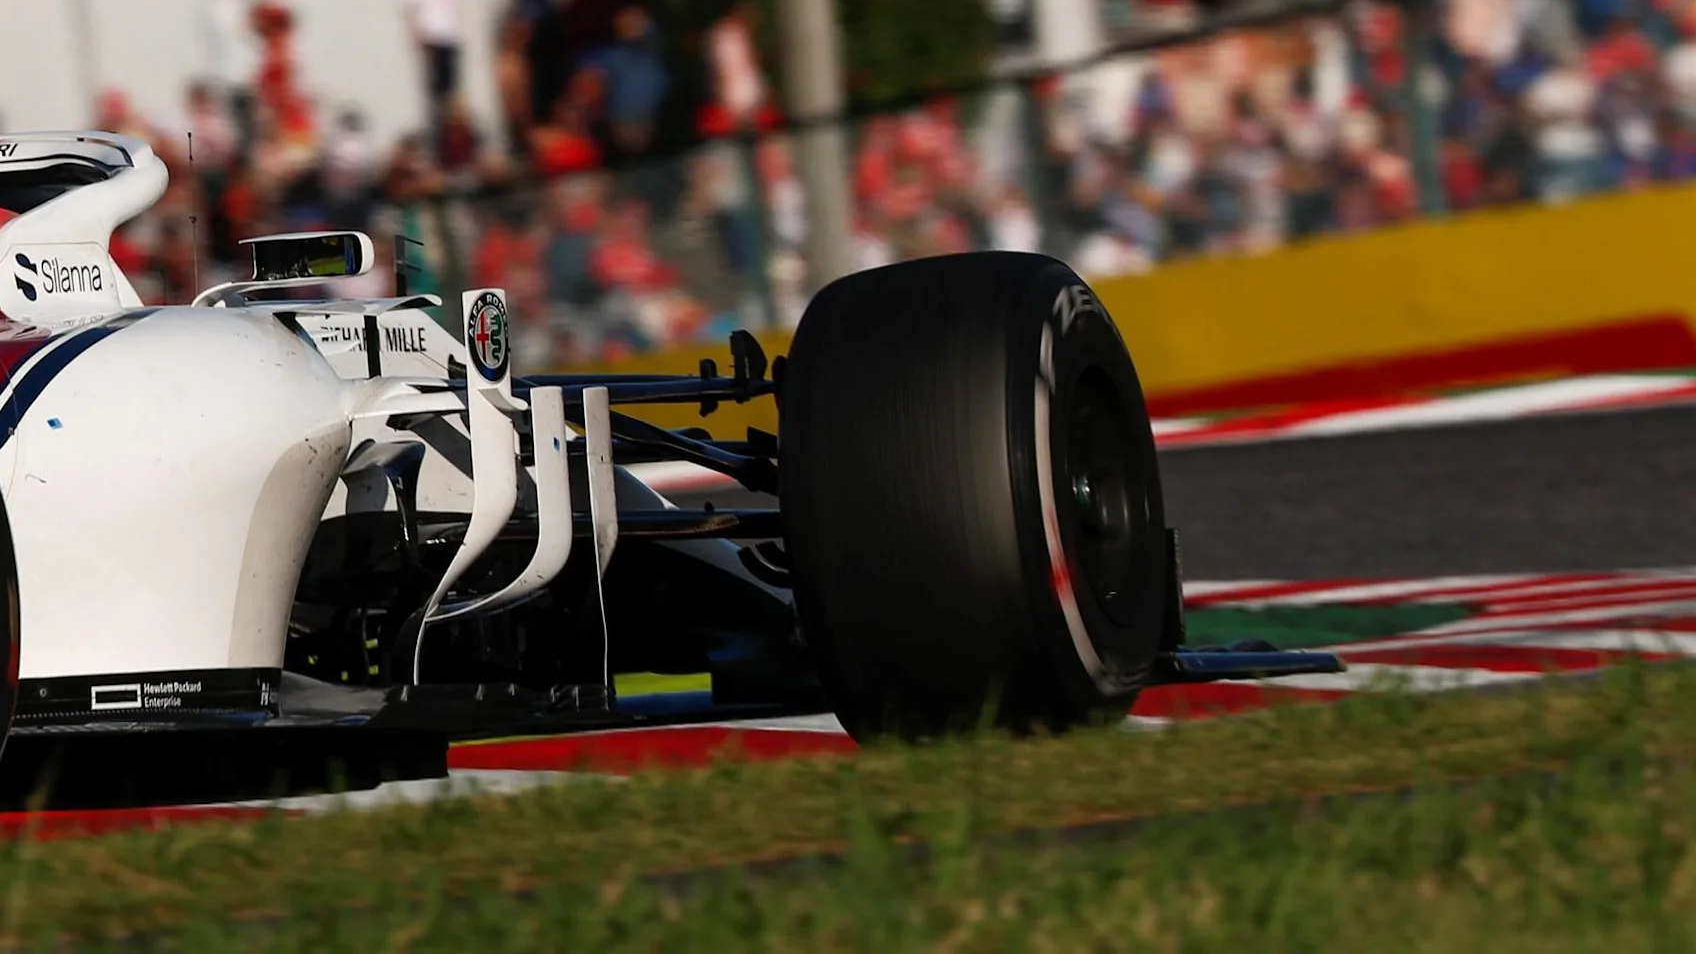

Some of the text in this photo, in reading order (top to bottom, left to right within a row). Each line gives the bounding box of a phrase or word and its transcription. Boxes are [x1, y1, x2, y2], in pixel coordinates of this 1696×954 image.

[41, 257, 103, 294] Silanna
[385, 327, 427, 353] MILLE
[144, 696, 182, 710] Enterprise
